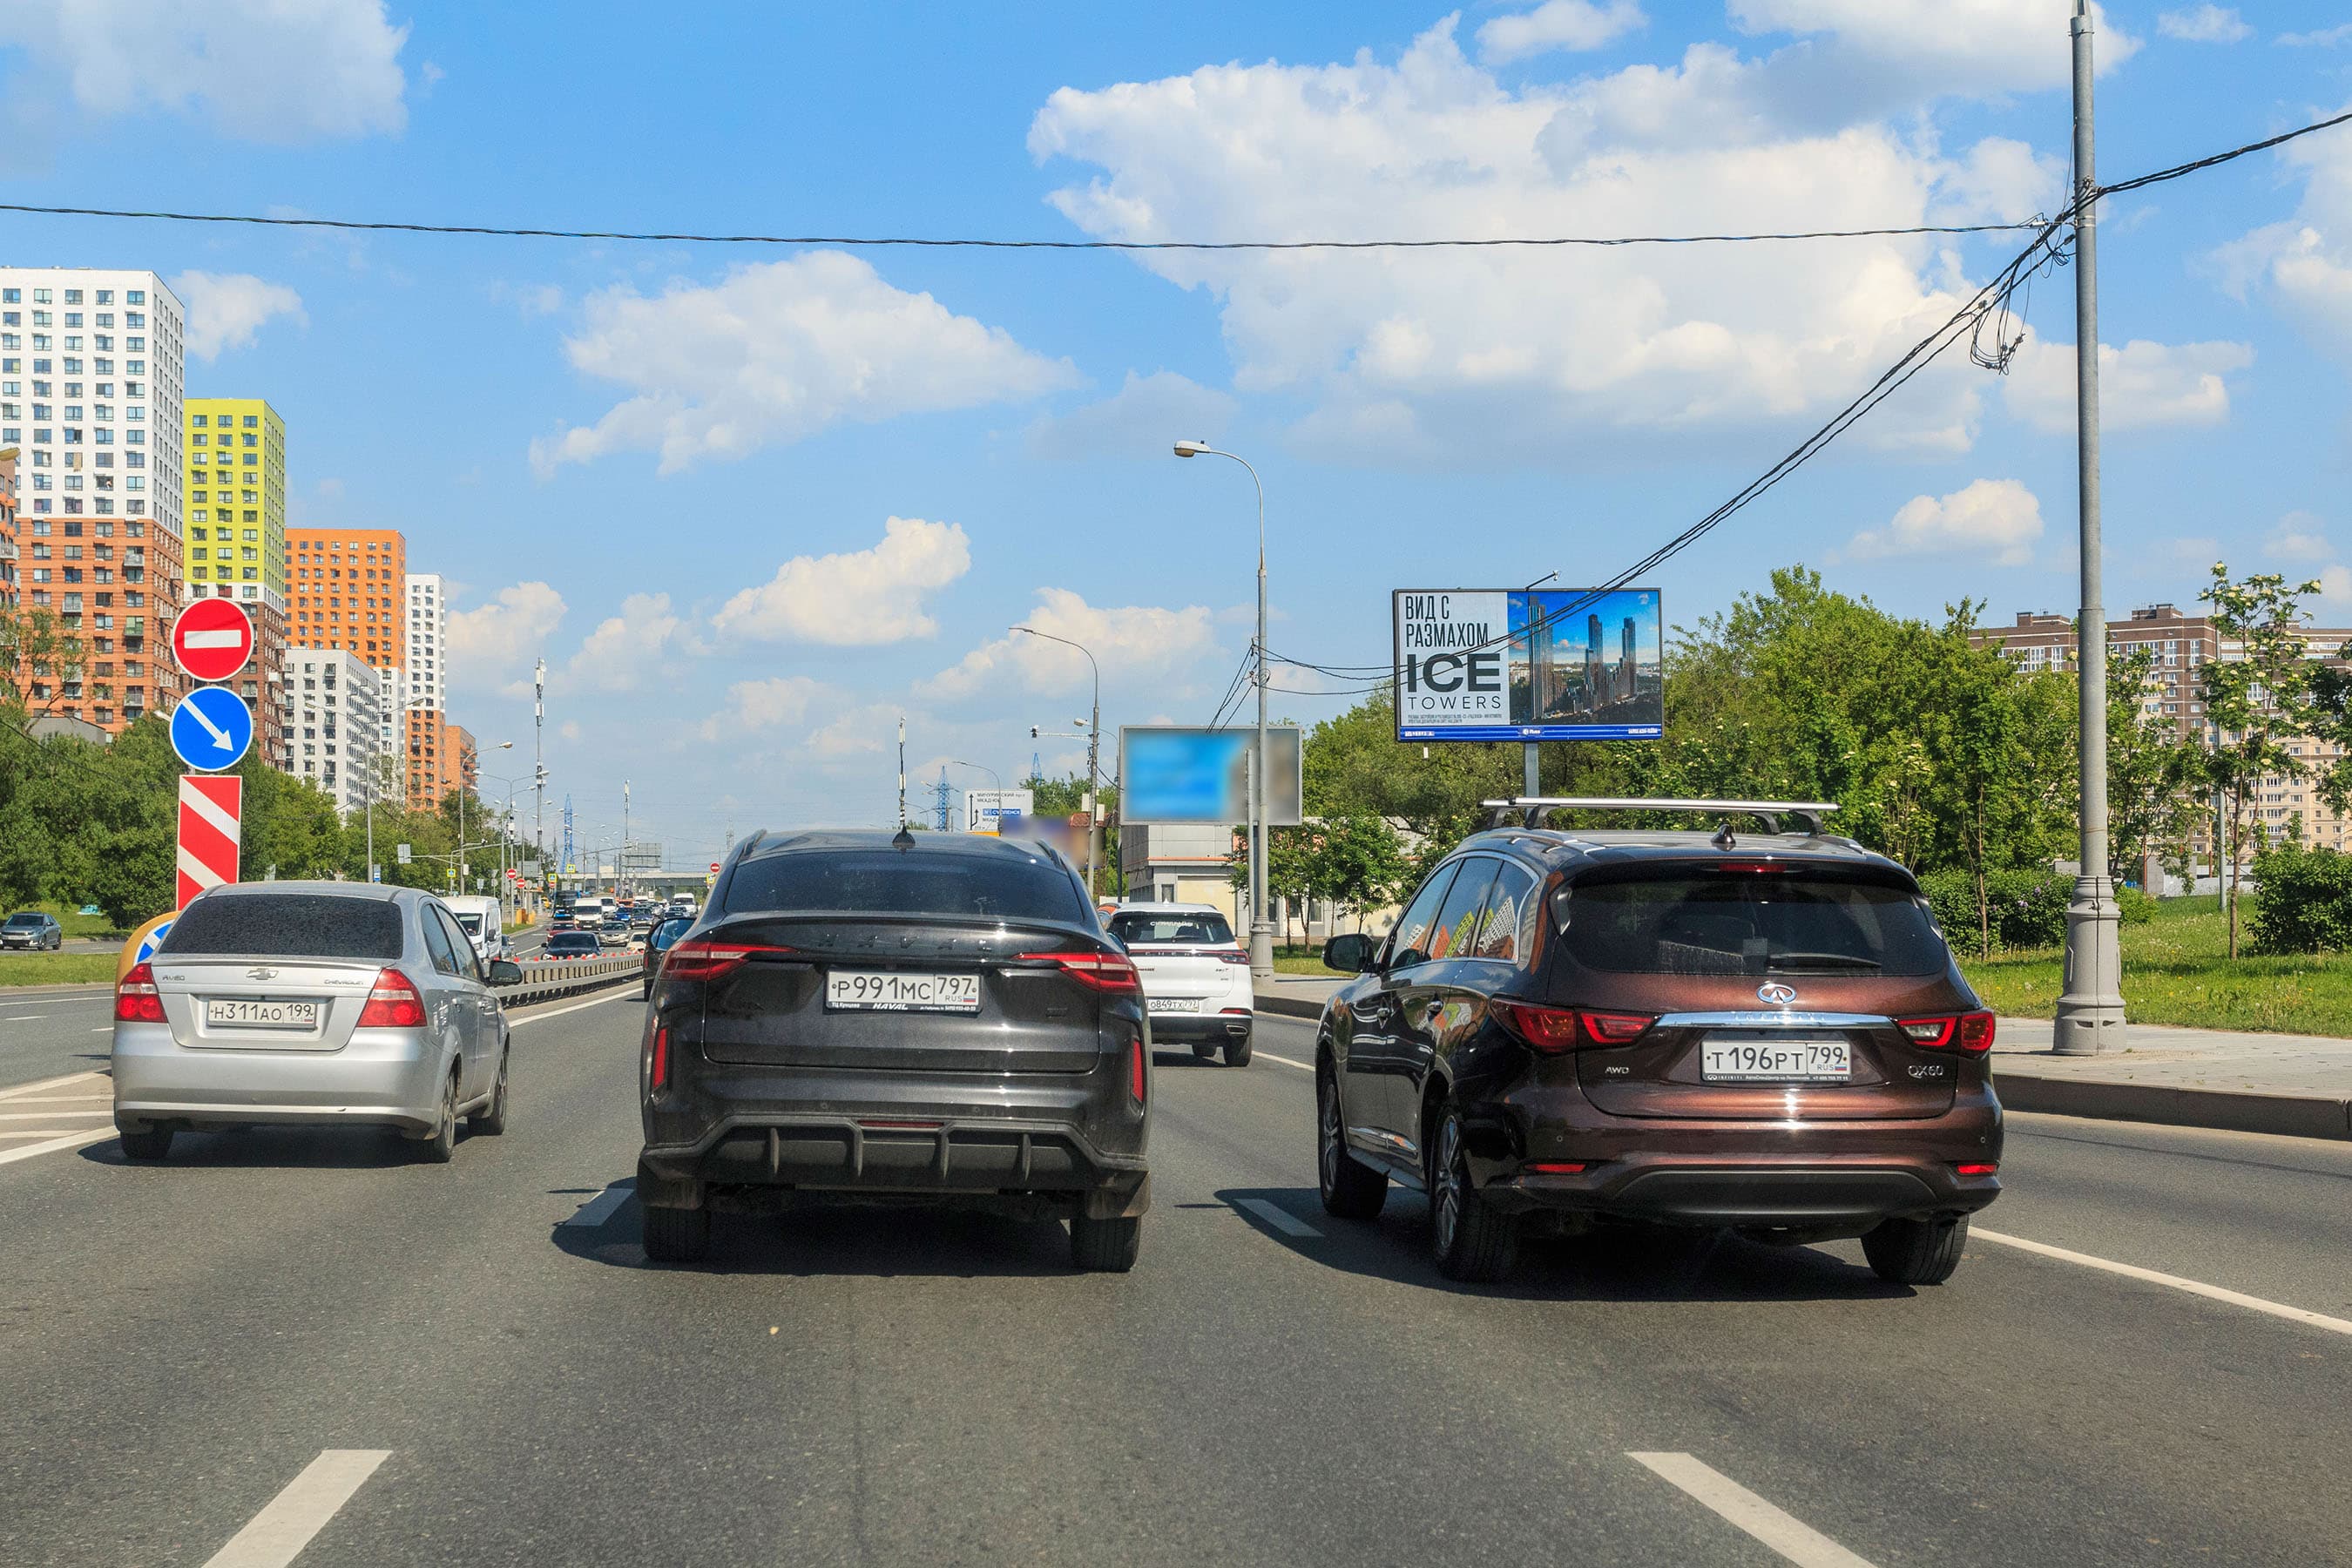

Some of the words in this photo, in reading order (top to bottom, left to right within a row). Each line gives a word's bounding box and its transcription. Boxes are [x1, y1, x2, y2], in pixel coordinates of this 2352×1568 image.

[1405, 595, 1436, 622] ВИД
[1441, 595, 1450, 619] С
[1405, 622, 1489, 647] РАЗМАХОМ
[1407, 653, 1501, 693] ICE
[1408, 696, 1501, 710] TOWERS
[1908, 1064, 1943, 1079] QX60
